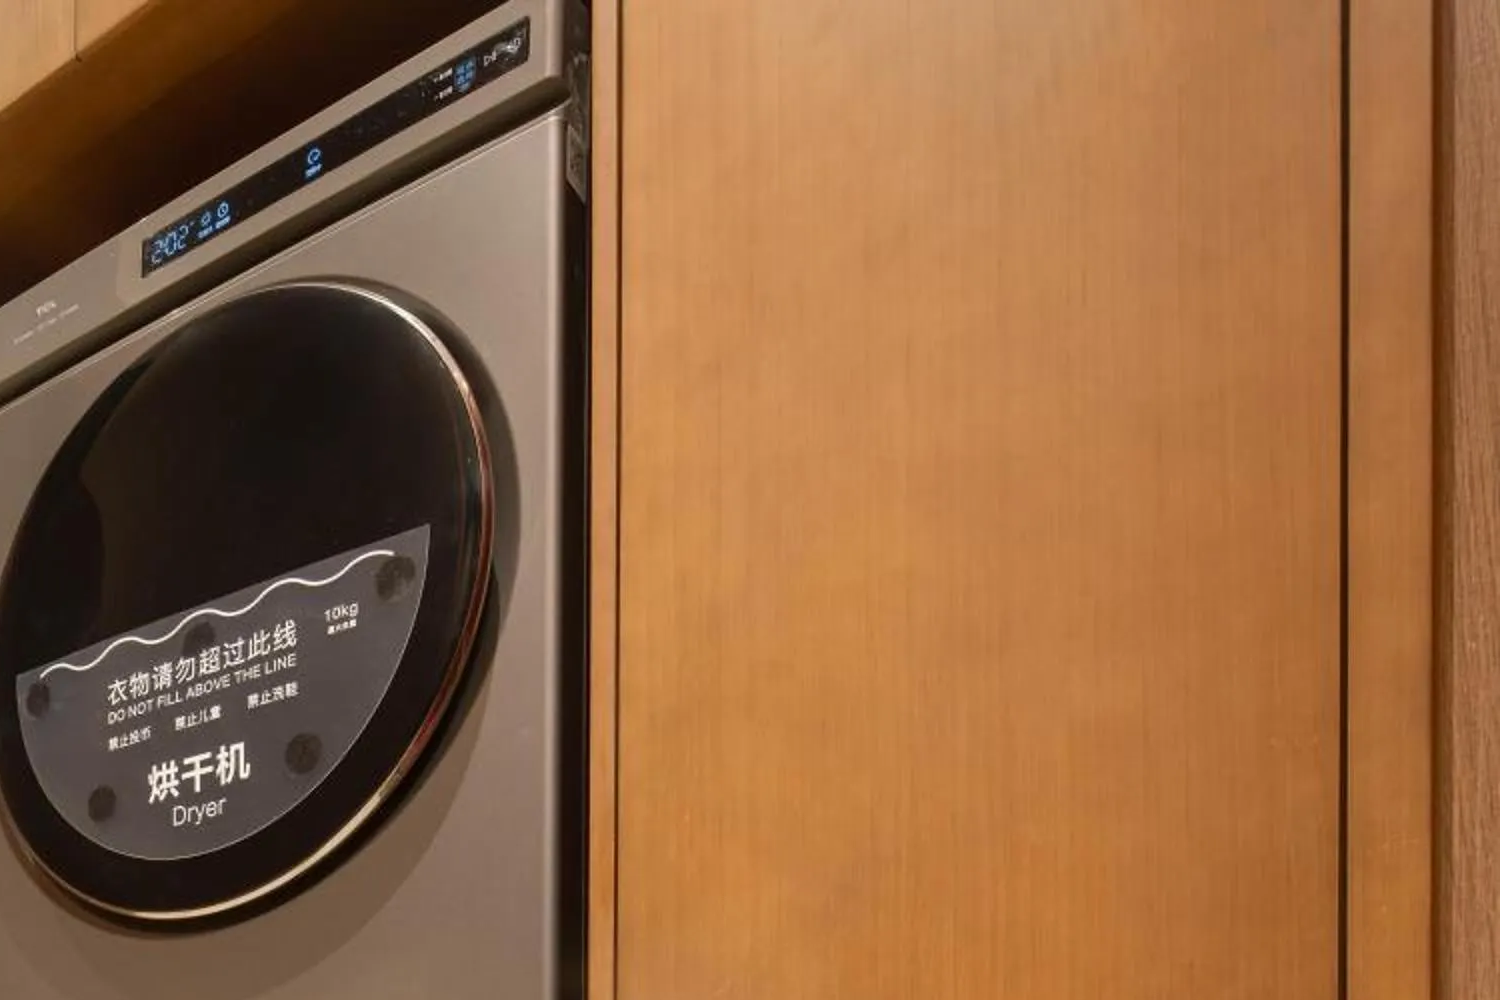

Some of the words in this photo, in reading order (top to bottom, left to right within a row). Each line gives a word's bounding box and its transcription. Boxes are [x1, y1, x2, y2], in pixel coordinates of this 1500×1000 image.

[324, 603, 358, 623] 10kg
[107, 619, 297, 705] 衣物请勿超过此线
[108, 709, 126, 725] DO
[127, 699, 154, 718] NOT
[157, 691, 184, 709] FILL
[185, 675, 231, 701] ABOVE
[235, 665, 261, 684] THE
[264, 653, 297, 673] LINE
[148, 740, 252, 804] 烘干机
[172, 796, 226, 827] Dryer
